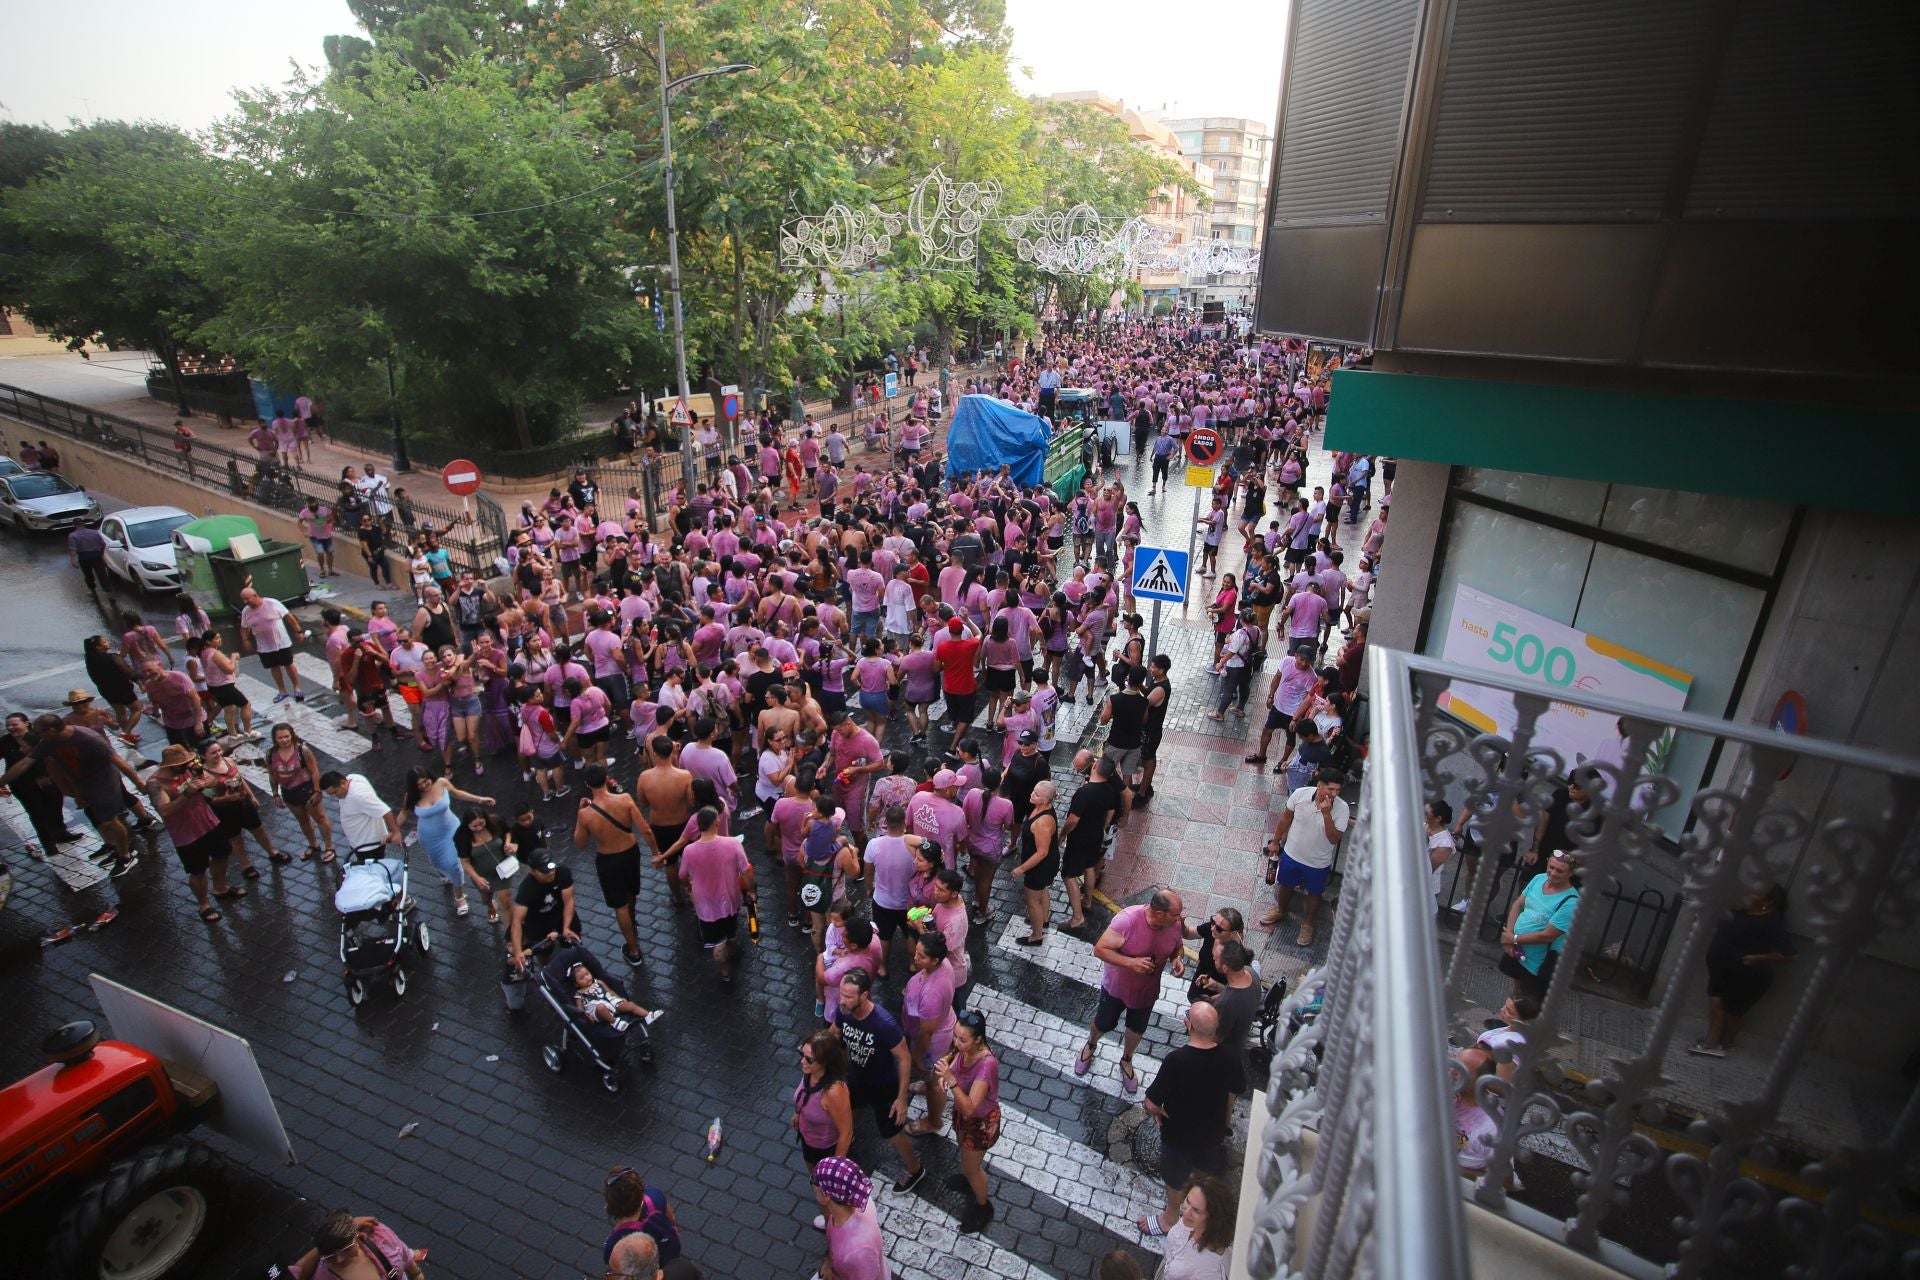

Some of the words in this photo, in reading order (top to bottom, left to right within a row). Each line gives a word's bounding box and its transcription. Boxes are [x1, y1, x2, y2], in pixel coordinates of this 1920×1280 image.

[1194, 434, 1215, 442] AMBOS
[1462, 618, 1489, 639] hasta
[842, 1022, 864, 1042] TODAY
[865, 1032, 874, 1046] IS
